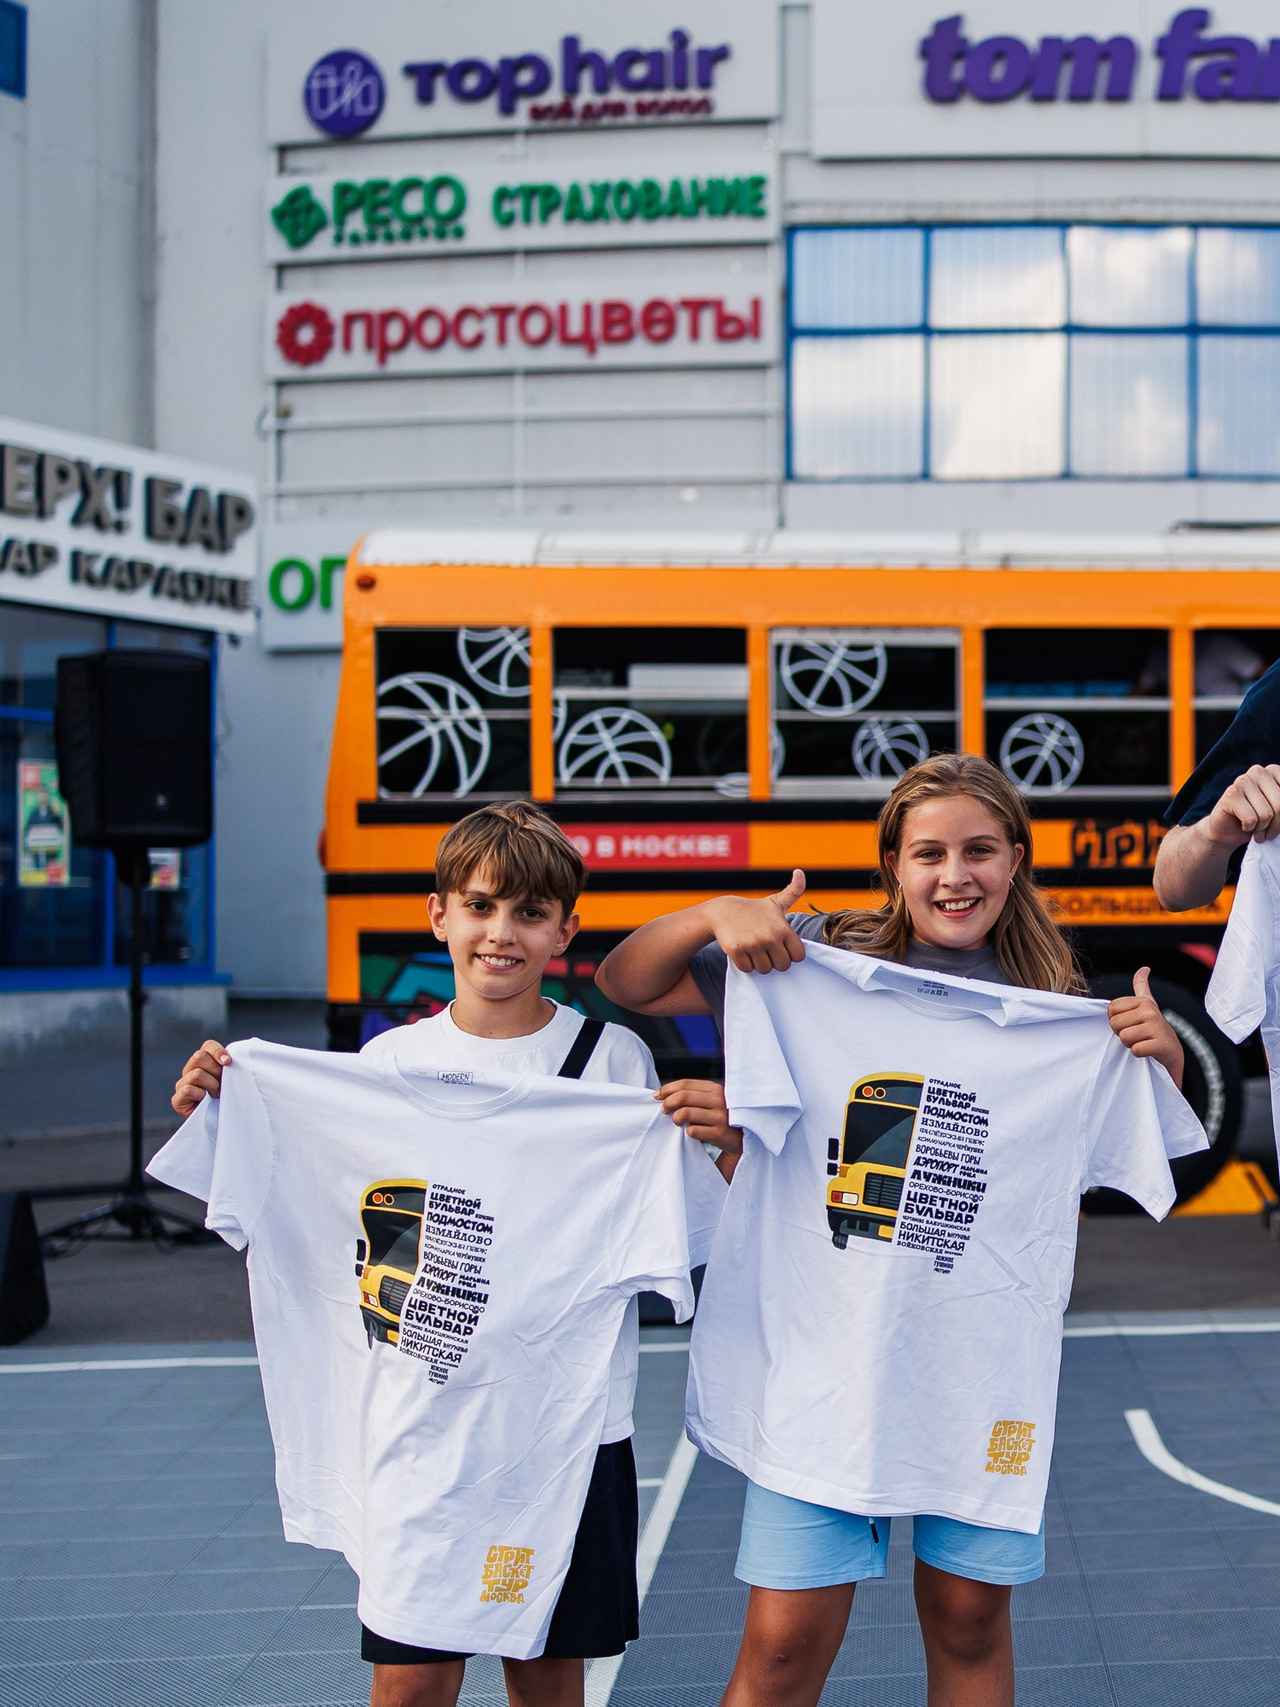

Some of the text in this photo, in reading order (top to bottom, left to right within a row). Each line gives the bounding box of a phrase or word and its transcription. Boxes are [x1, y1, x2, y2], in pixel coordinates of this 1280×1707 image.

[918, 14, 1137, 105] tom
[333, 175, 768, 227] РЕСО СТРАХОВАНИЕ
[145, 476, 254, 555] БАР
[70, 550, 253, 613] КАРАОКЕ
[596, 835, 615, 857] В
[621, 835, 731, 858] МОСКВЕ
[929, 1079, 961, 1089] ОТРАДНОЕ
[926, 1094, 971, 1110] БУЛЬВАР
[927, 1086, 977, 1103] ЦВЕТНОЙ
[923, 1105, 989, 1127] ПОДМОСТОМ
[921, 1117, 988, 1138] ИЗМАЙЛОВО
[913, 1156, 960, 1173] АЭРОПОРТ
[960, 1154, 981, 1165] ГОРЫ
[432, 1184, 466, 1195] ОТРАДНОЕ
[910, 1169, 987, 1193] ЛУЖНИКИ
[430, 1192, 481, 1209] ЦВЕТНОЙ
[906, 1190, 979, 1214] ЦВЕТНОЙ
[909, 1182, 984, 1202] ОРЕХОВО-БОРИСОВО
[429, 1201, 475, 1216] БУЛЬВАР
[904, 1203, 974, 1225] БУЛЬВАР
[427, 1212, 493, 1234] ПОДМОСТОМ
[900, 1221, 946, 1237] БОЛЬШАЯ
[426, 1224, 492, 1246] ИЗМАЙЛОВО
[898, 1230, 965, 1251] НИКИТСКАЯ
[459, 1262, 482, 1275] ГОРЫ
[416, 1276, 489, 1304] ЛУЖНИКИ
[413, 1289, 485, 1313] ОРЕХОВО-БОРИСОВО
[408, 1297, 479, 1326] ЦВЕТНОЙ
[405, 1309, 474, 1336] БУЛЬВАР
[403, 1328, 442, 1347] БОЛЬШАЯ
[401, 1337, 462, 1363] НИКИТСКАЯ
[992, 1420, 1036, 1439] СТРИТ
[987, 1436, 1036, 1452] БАСКЕТ
[985, 1461, 1027, 1476] МОСКВА
[988, 1452, 1030, 1465] ТУР
[486, 1545, 535, 1566] СТРИТ
[482, 1563, 534, 1579] БАСКЕТ
[482, 1579, 528, 1592] ТУР
[479, 1590, 524, 1604] МОСКВА
